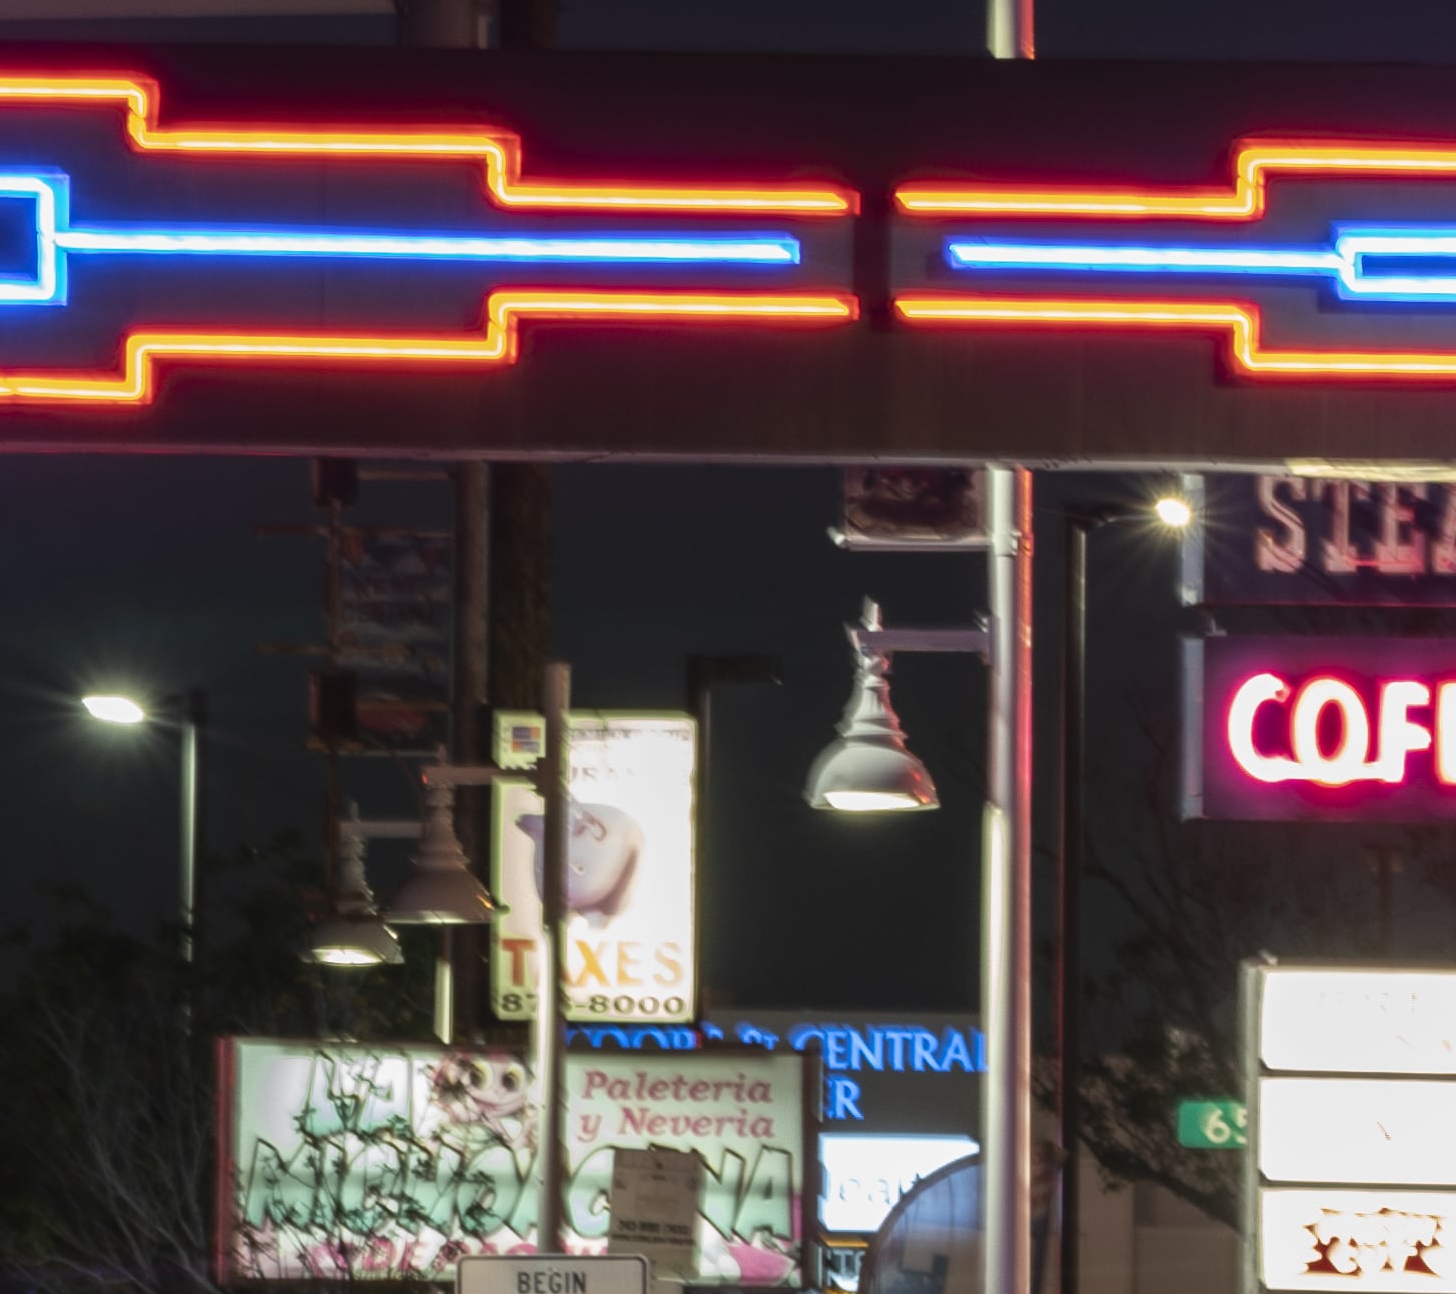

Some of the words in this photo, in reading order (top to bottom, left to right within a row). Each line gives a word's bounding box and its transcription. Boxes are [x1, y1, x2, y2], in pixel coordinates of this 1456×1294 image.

[501, 938, 685, 988] TXES
[501, 993, 687, 1016] 8-8000
[581, 1070, 773, 1104] Paleteria
[577, 1113, 601, 1143] y
[617, 1105, 775, 1138] Neveria
[242, 1136, 793, 1243] MICHOCNA
[517, 1272, 587, 1294] BEGIN
